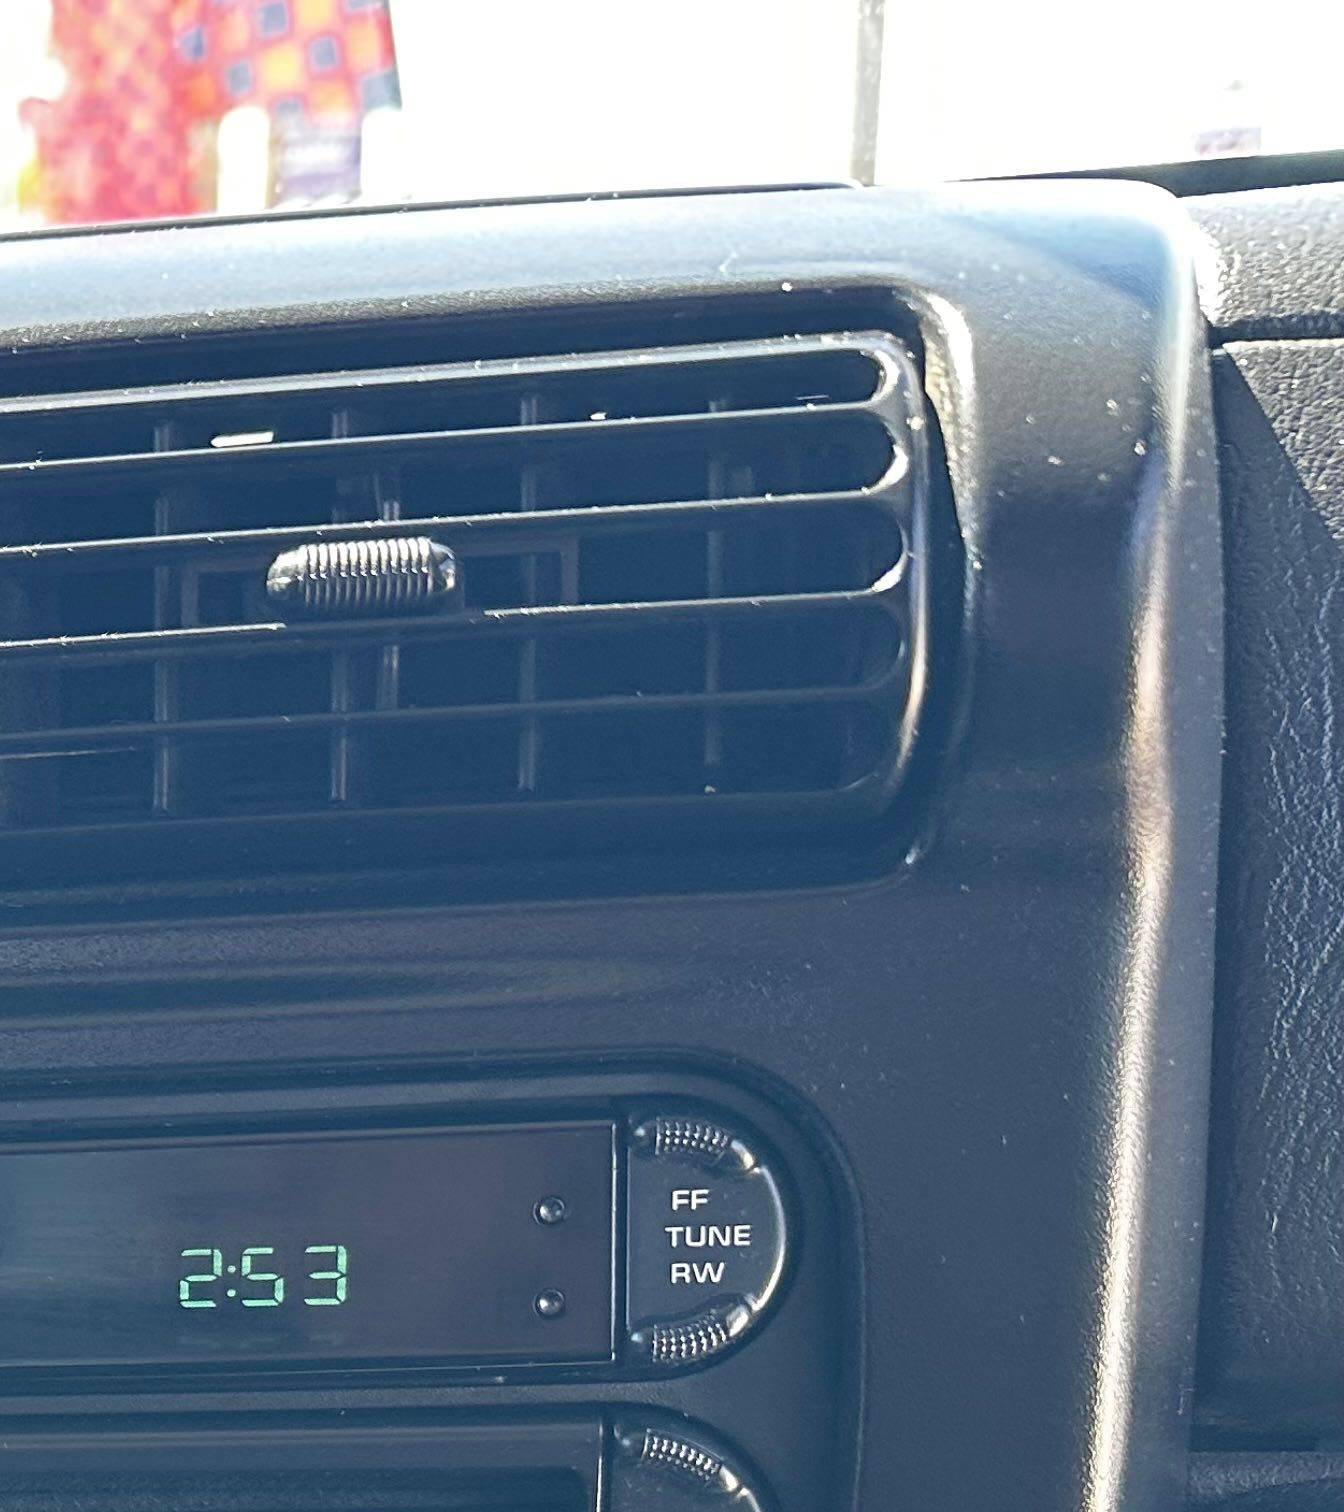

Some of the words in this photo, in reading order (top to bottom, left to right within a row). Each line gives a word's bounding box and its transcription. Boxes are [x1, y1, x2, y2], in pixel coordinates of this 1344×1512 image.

[670, 1189, 710, 1211] FF
[664, 1225, 752, 1248] TUNE
[179, 1245, 348, 1308] 2:53
[670, 1262, 724, 1284] RW
